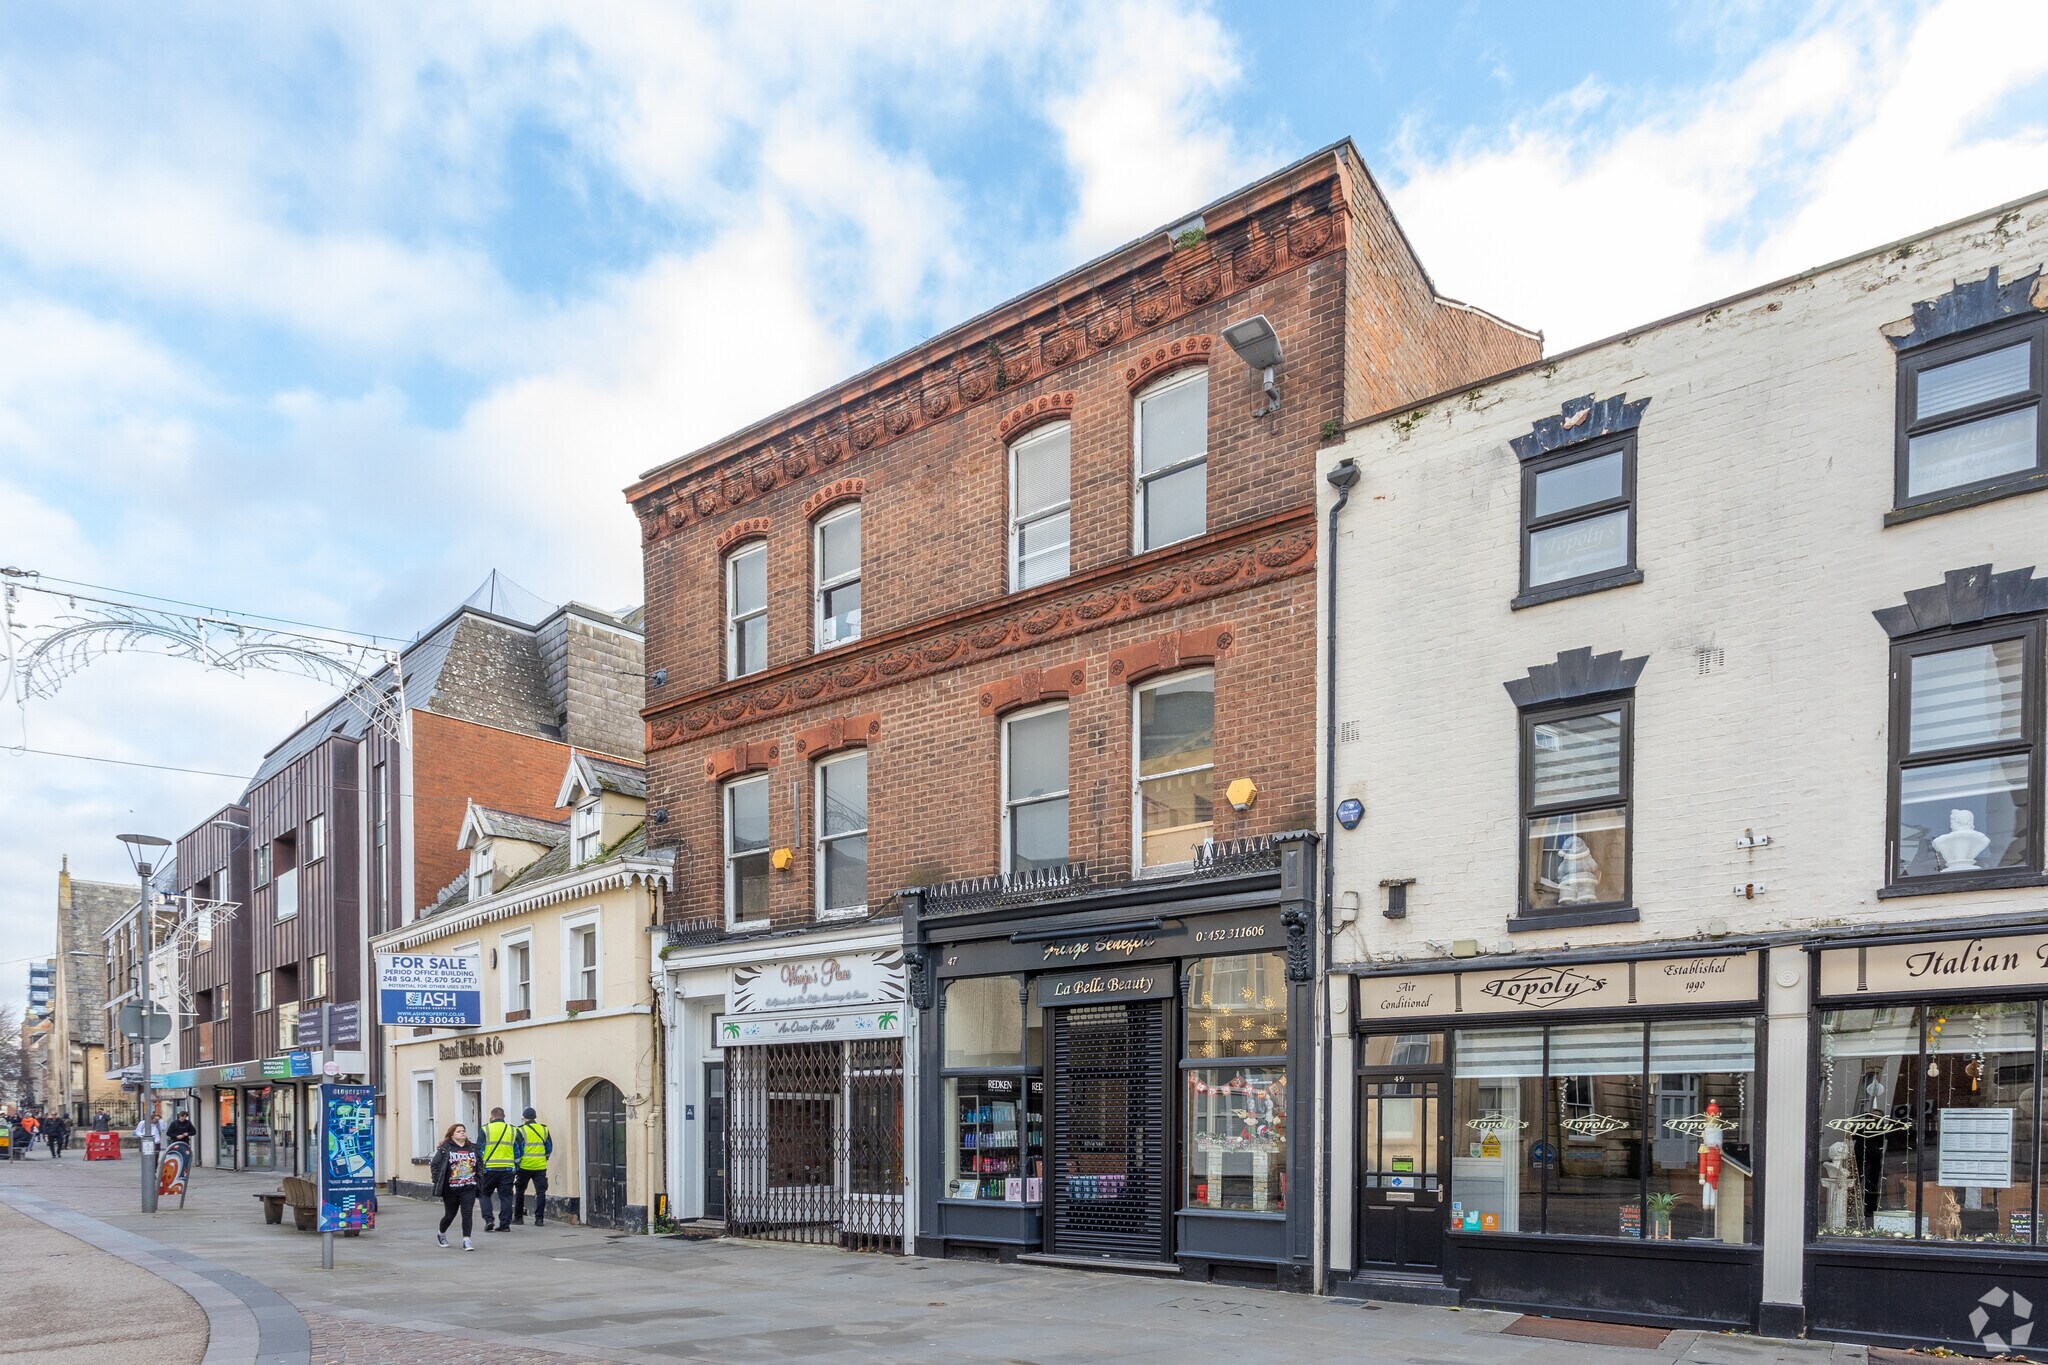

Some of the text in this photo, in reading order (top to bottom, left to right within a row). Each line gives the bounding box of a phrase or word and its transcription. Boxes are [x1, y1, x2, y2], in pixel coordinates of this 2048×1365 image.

[1227, 925, 1265, 939] 311606
[1042, 934, 1155, 960] Fringe Benefits
[392, 957, 467, 970] FOR SALE
[947, 956, 958, 966] 47
[1905, 939, 2020, 977] Italian
[1663, 957, 1731, 976] Established
[1054, 976, 1154, 996] La Bella Beauty
[1396, 981, 1417, 993] Air
[1482, 968, 1607, 1005] Topoly's
[1685, 981, 1705, 993] 1990
[422, 992, 456, 1007] ASH
[1380, 993, 1433, 1010] Conditioned
[397, 1016, 466, 1024] 01452 300433
[485, 1036, 492, 1056] &
[493, 1035, 504, 1056] Co
[988, 1080, 1013, 1089] REDKEN
[1393, 1075, 1405, 1083] 49
[1561, 1115, 1630, 1134] Topoly's
[1826, 1115, 1913, 1135] Topoly's
